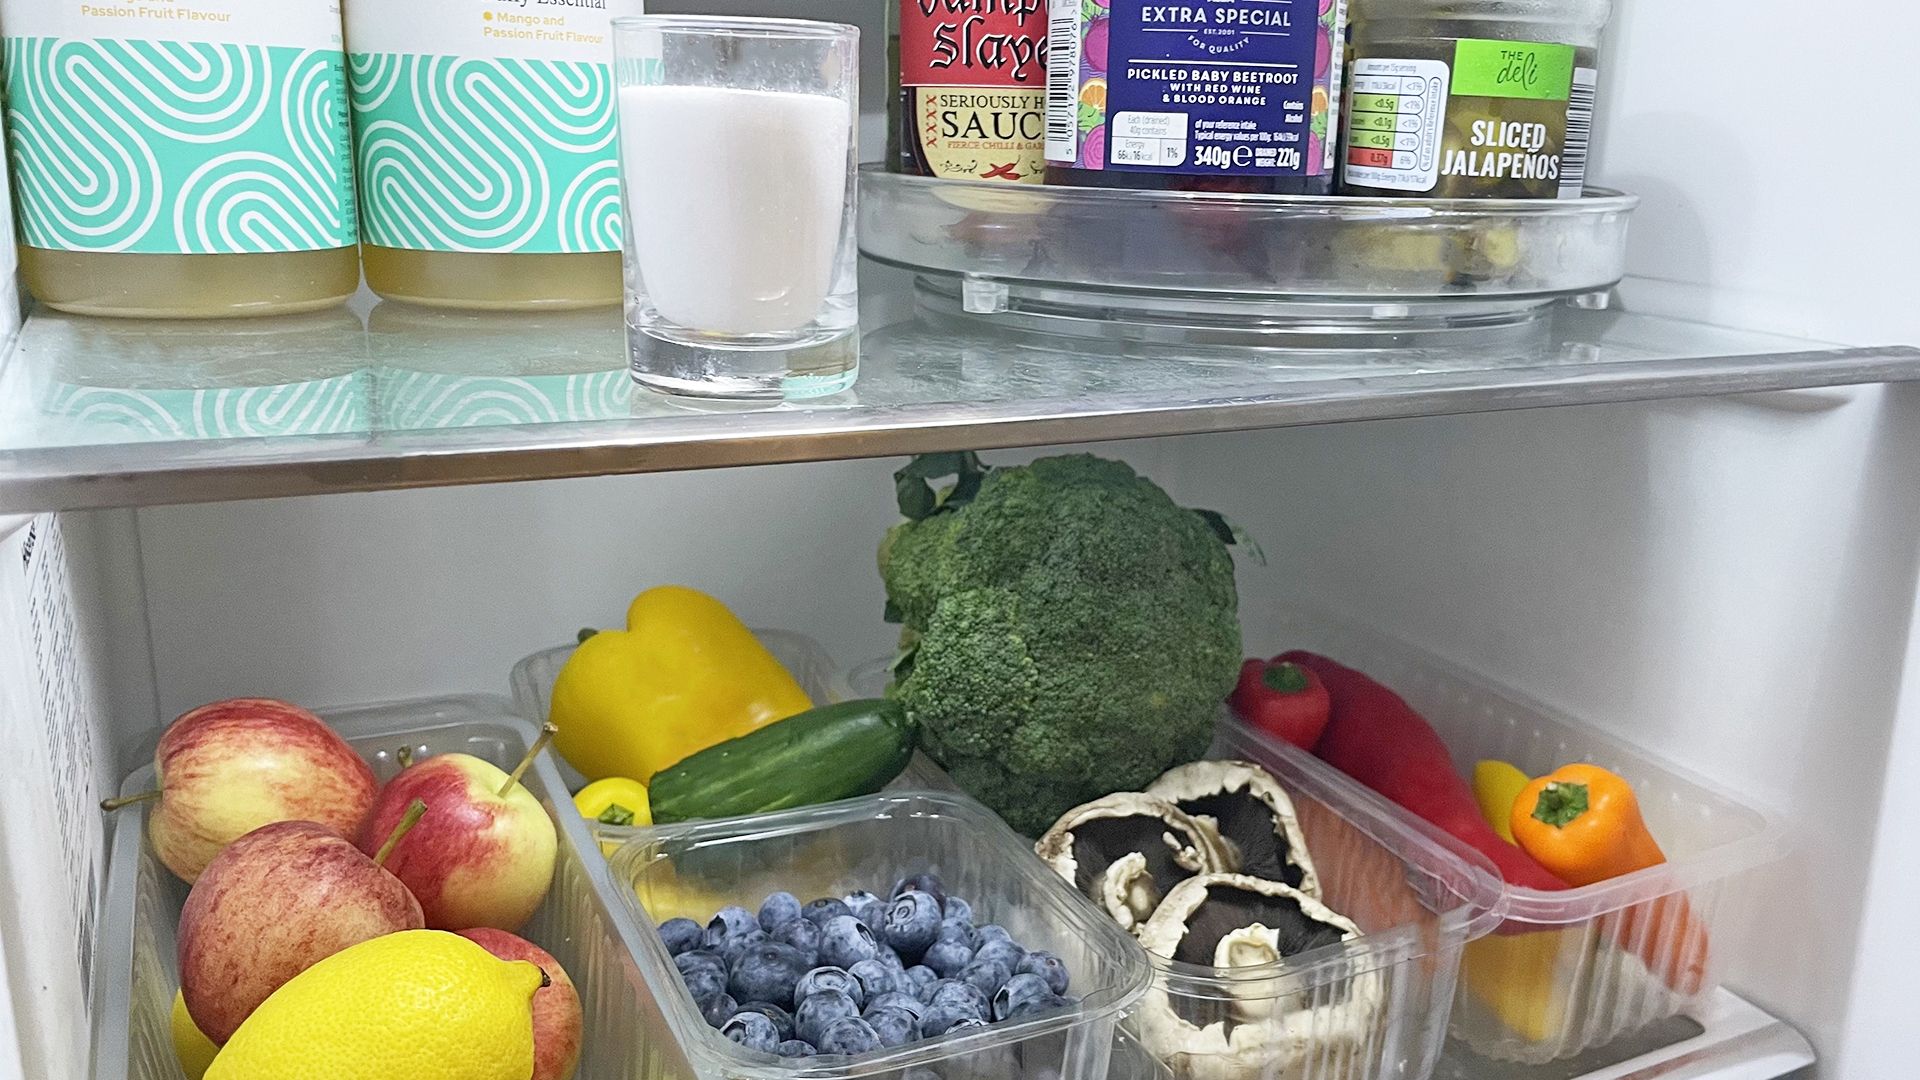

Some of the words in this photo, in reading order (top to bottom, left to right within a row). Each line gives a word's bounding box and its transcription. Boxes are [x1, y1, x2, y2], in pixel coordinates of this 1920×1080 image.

[81, 5, 135, 17] Passion
[139, 7, 174, 19] Fruit
[177, 9, 231, 22] Flavour
[497, 12, 540, 26] Mango
[543, 16, 565, 26] and
[1142, 6, 1207, 23] EXTRA
[1215, 8, 1291, 27] SPECIAL
[483, 27, 533, 40] Passion
[536, 30, 564, 41] Fruit
[566, 31, 604, 43] Flavour
[1187, 34, 1206, 50] FOR
[1208, 37, 1250, 54] QUALITY
[929, 14, 1047, 82] Slaye
[1501, 50, 1523, 60] THE
[1127, 68, 1187, 80] PICKLED
[1191, 70, 1229, 82] BABY
[1232, 71, 1298, 84] BEETROOT
[1497, 52, 1538, 90] deli
[1170, 83, 1201, 92] WITH
[1205, 84, 1228, 93] RED
[1231, 84, 1261, 94] WINE
[940, 94, 1031, 109] SERIOUSLY
[1034, 96, 1044, 110] H
[1162, 93, 1170, 103] &
[1173, 94, 1215, 104] BLOOD
[1218, 95, 1266, 106] ORANGE
[942, 110, 1045, 140] SAUC
[1470, 120, 1546, 149] SLICED
[947, 141, 980, 150] FIERCE
[982, 141, 1014, 151] CHILLI
[1016, 142, 1024, 150] &
[1194, 146, 1231, 169] 340g
[1276, 147, 1300, 170] 221g
[1441, 147, 1560, 180] JALAPEÑOS
